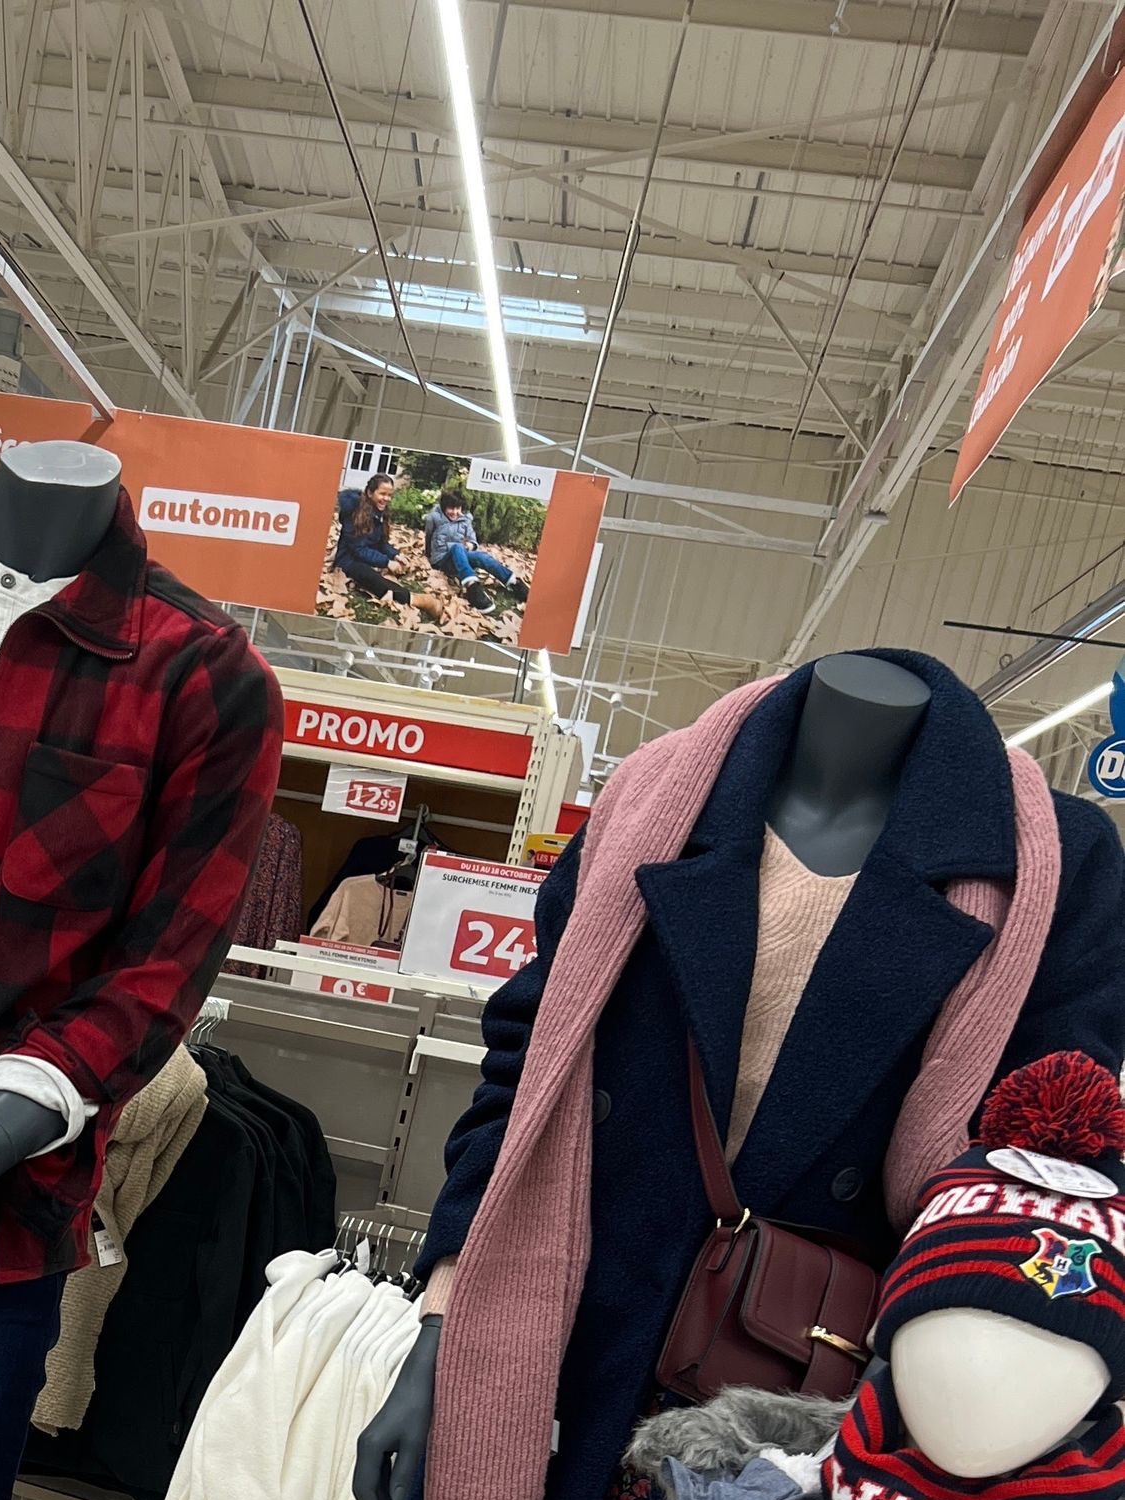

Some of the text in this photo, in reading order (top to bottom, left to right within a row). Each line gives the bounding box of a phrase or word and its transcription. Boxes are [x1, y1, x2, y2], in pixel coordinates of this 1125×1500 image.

[480, 466, 542, 488] Inextenso
[147, 498, 291, 534] automne
[296, 708, 425, 754] PROMO
[1099, 749, 1125, 780] D
[442, 874, 490, 887] SURCHEMISE
[491, 882, 518, 892] FEMME
[460, 862, 472, 870] DU
[480, 865, 491, 873] AU
[499, 868, 533, 880] OCTOBRE
